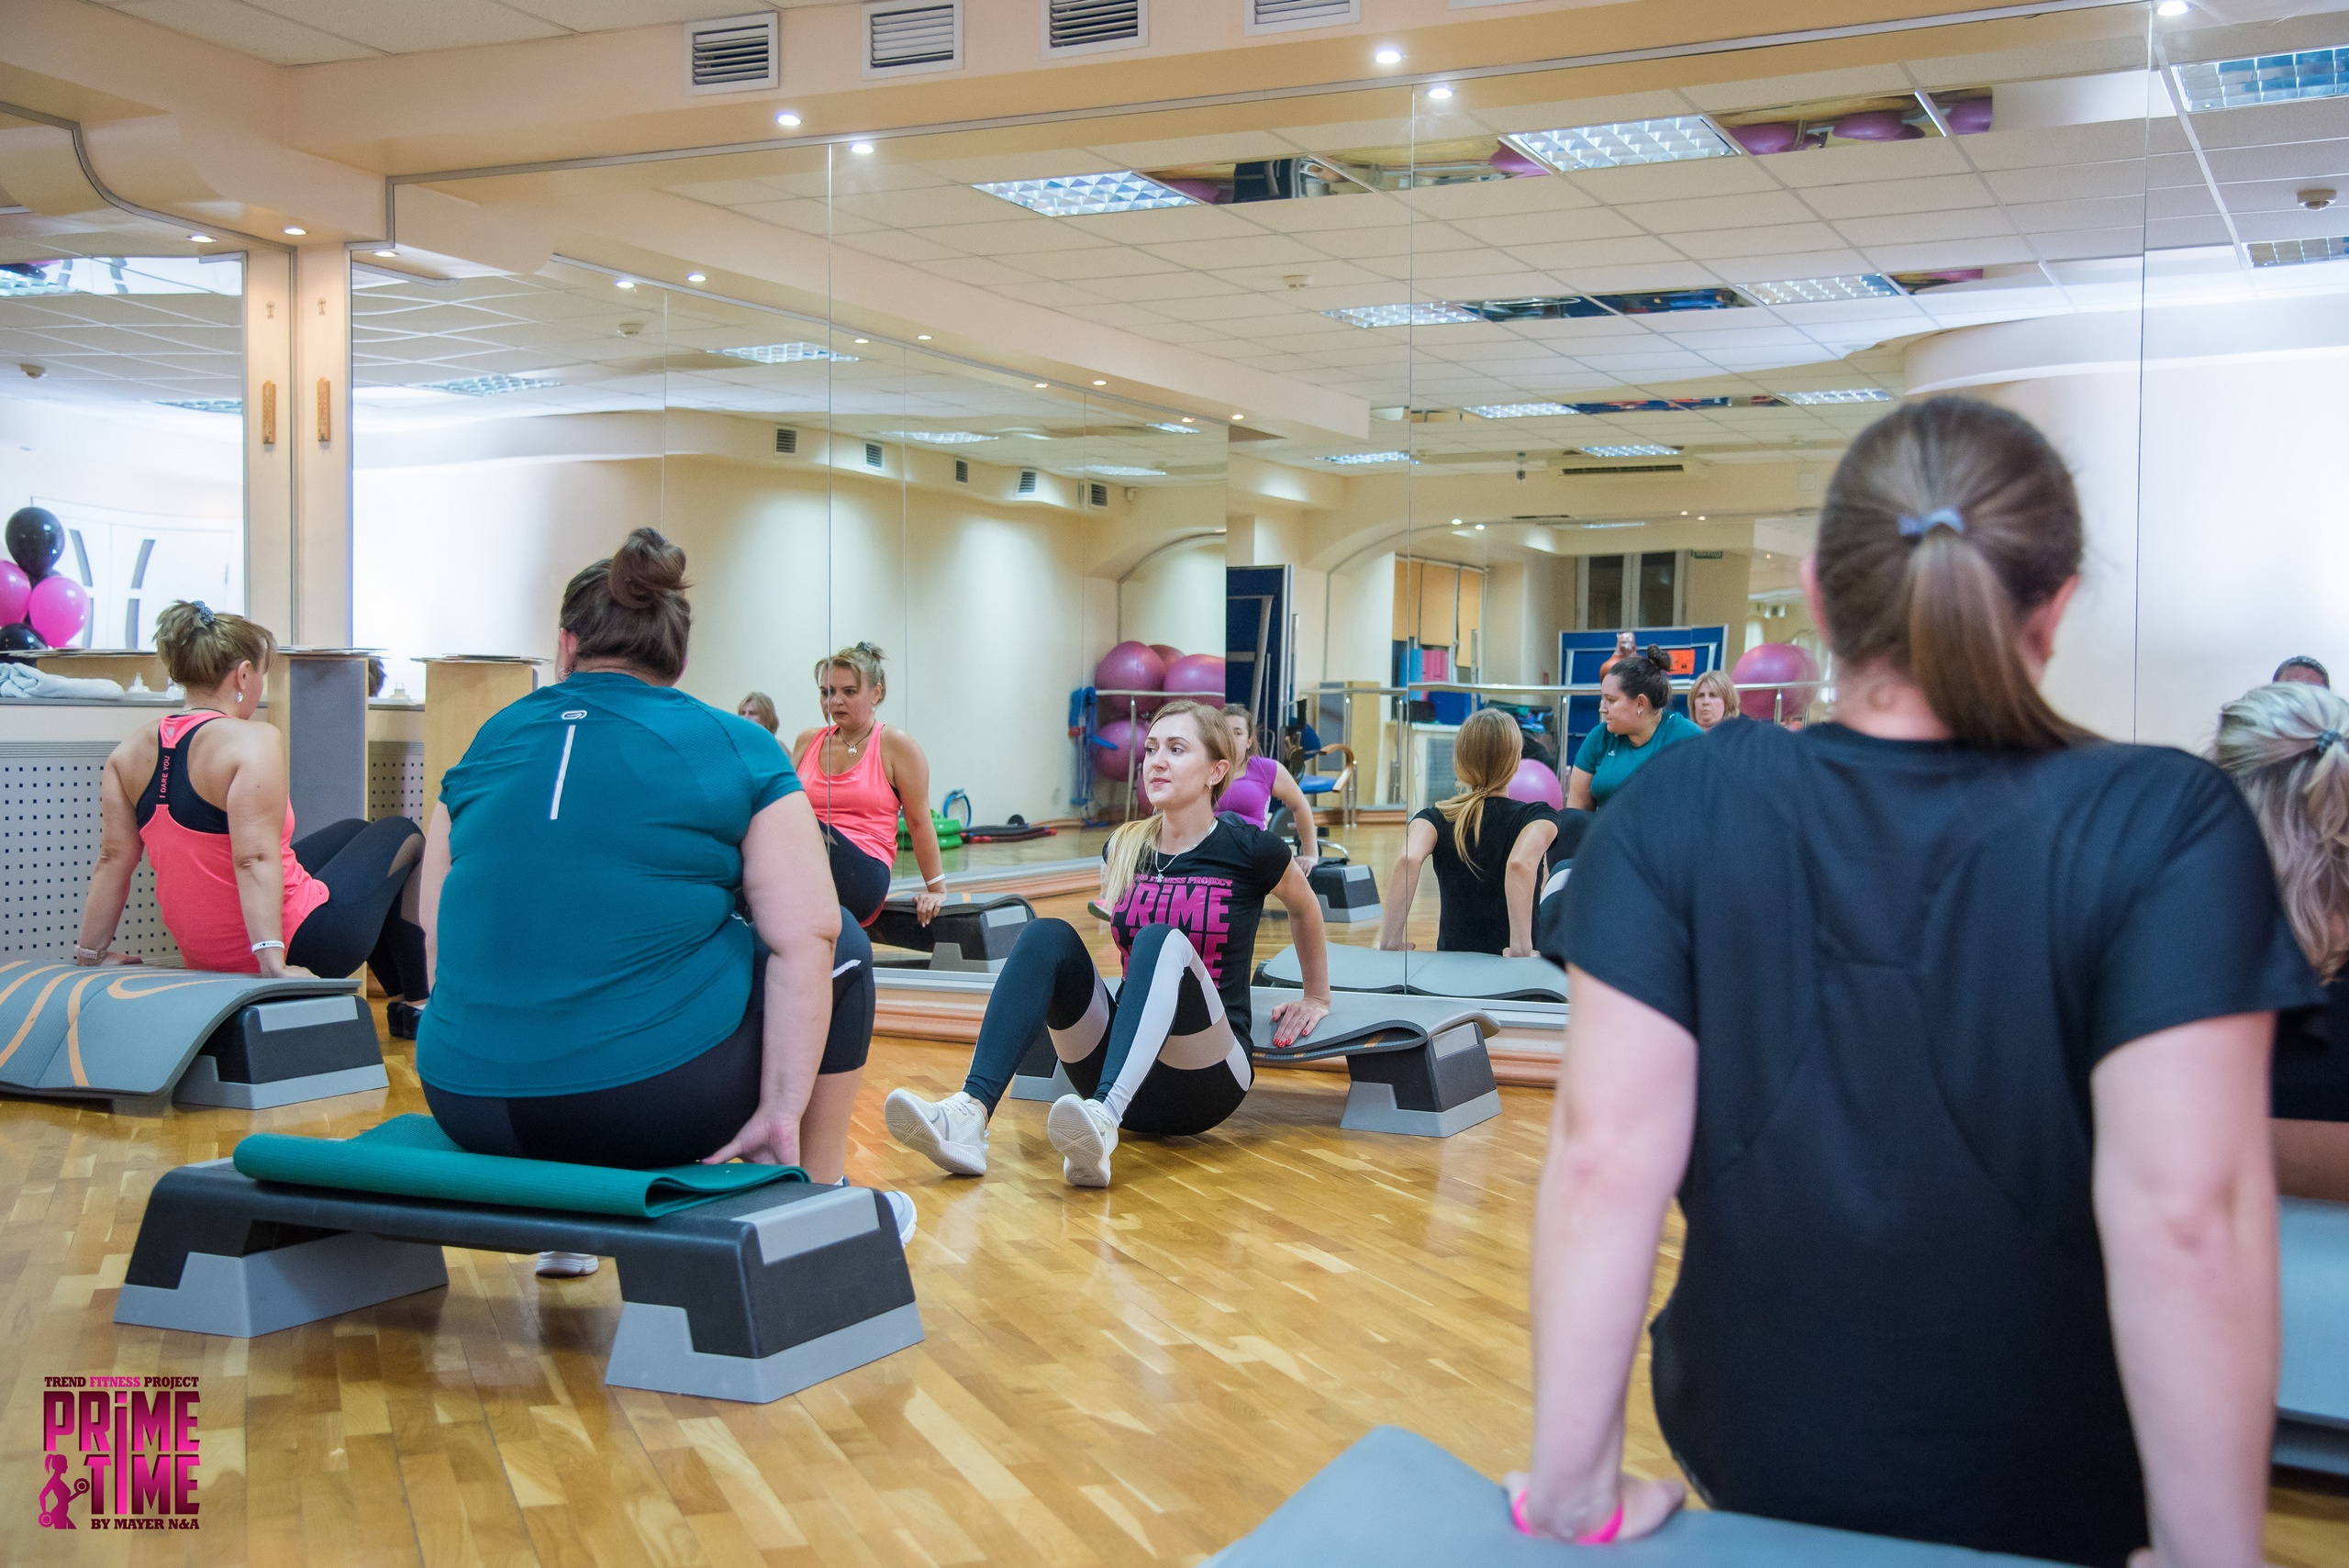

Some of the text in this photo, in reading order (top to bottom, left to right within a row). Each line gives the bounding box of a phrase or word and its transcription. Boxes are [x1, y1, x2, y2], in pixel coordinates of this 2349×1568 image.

[162, 755, 171, 771] YOU
[160, 773, 169, 793] DARE
[1186, 876, 1233, 886] PROJECT
